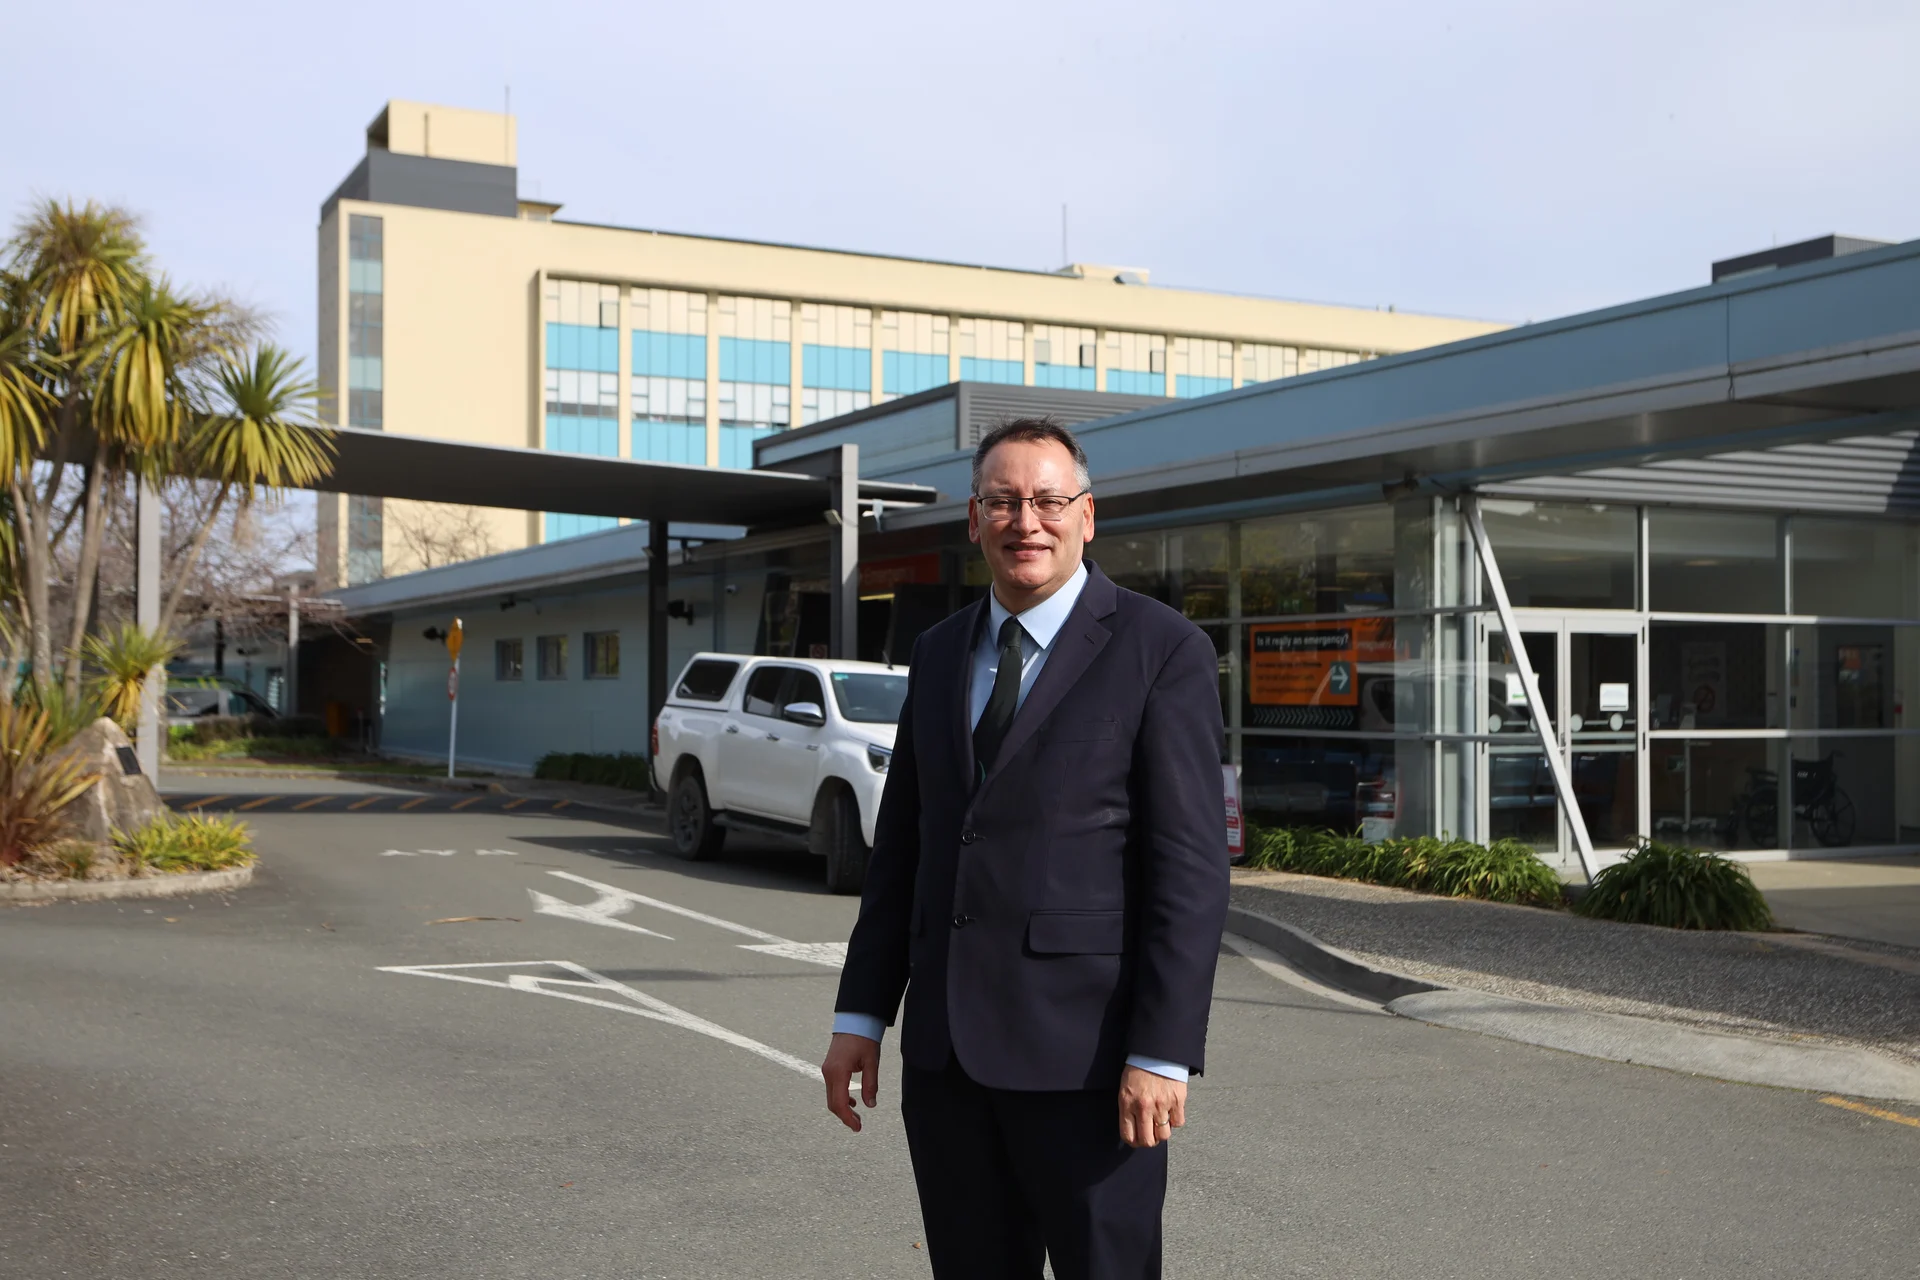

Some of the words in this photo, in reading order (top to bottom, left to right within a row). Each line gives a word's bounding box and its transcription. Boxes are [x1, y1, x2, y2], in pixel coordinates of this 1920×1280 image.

[1257, 636, 1264, 646] Is
[1265, 636, 1271, 646] it
[1272, 635, 1292, 648] really
[1293, 637, 1302, 645] an
[1304, 633, 1349, 647] emergency?
